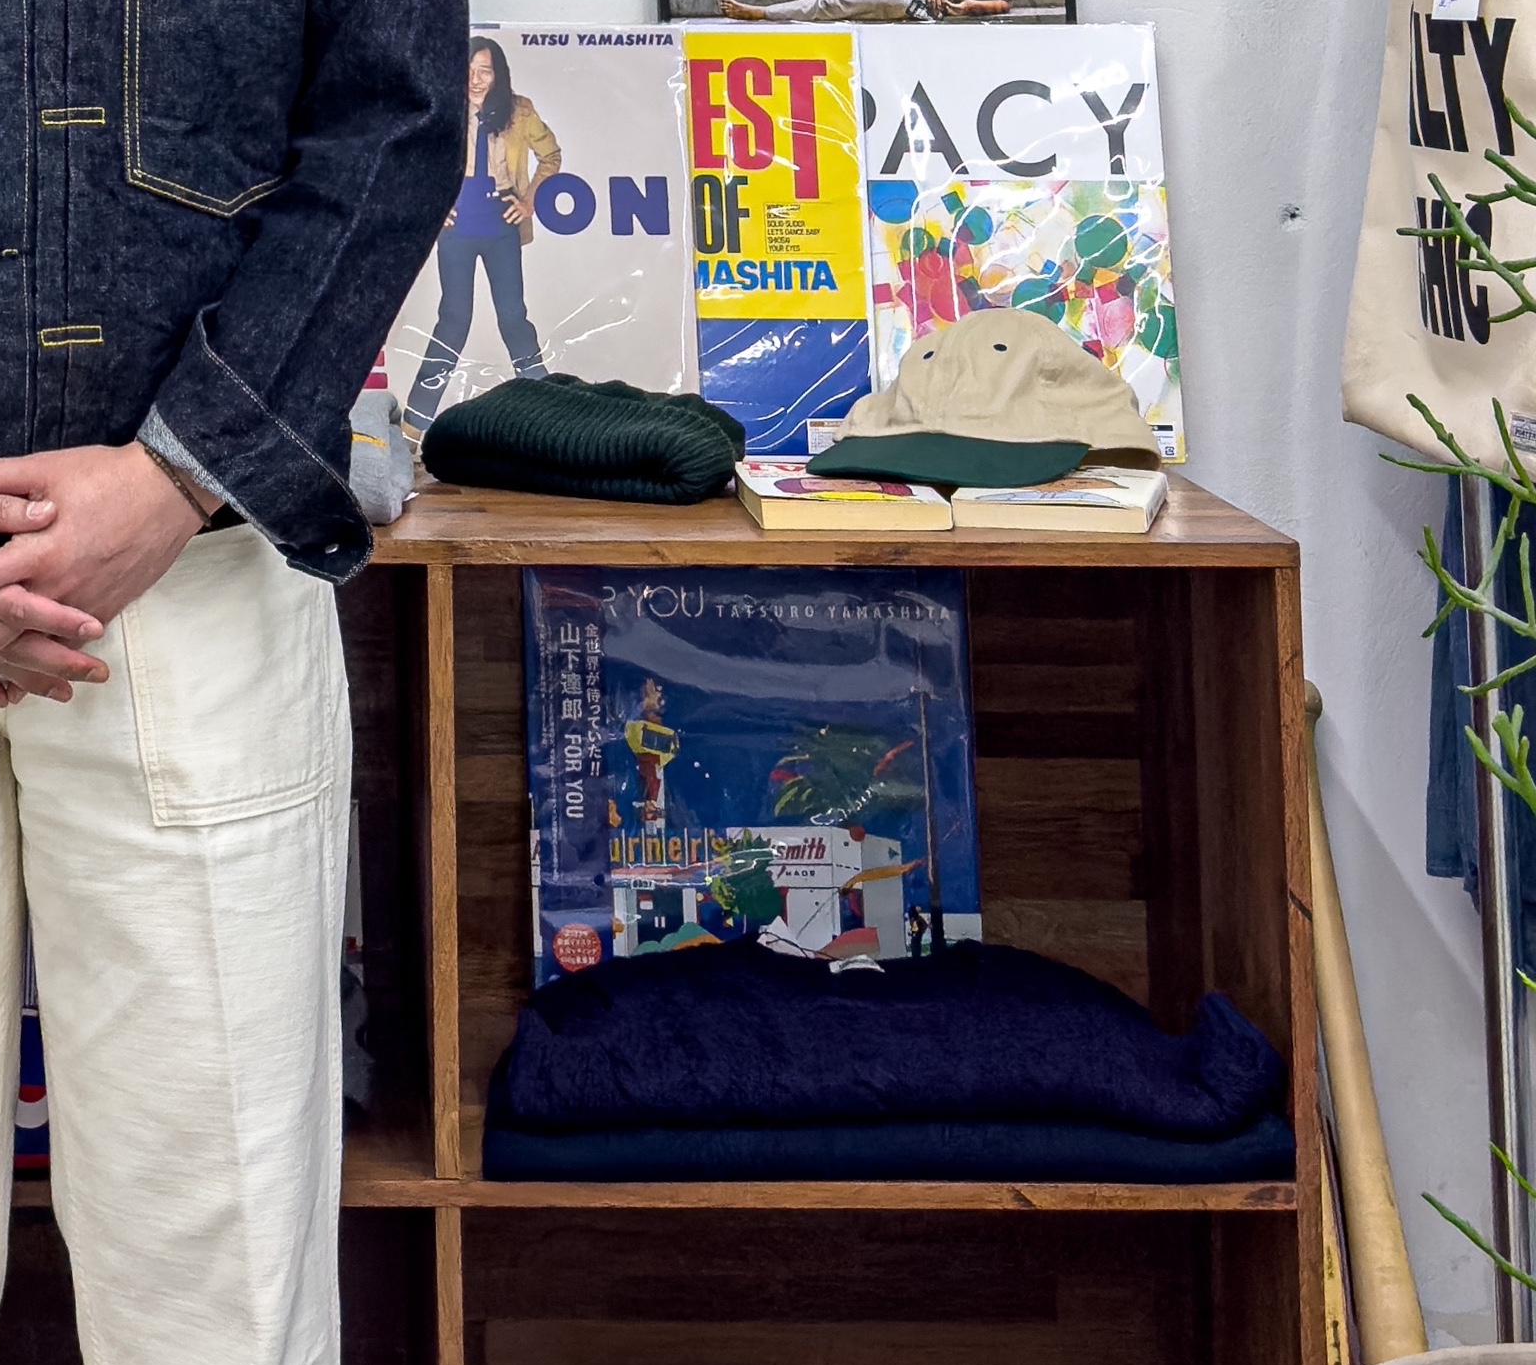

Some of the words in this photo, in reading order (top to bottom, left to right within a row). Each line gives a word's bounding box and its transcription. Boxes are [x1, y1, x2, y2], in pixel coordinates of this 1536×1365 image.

[520, 32, 570, 47] TATSU
[576, 32, 675, 47] YAMASHITA
[1410, 3, 1517, 157] LTY
[533, 172, 671, 236] ON
[693, 175, 750, 255] OF
[785, 244, 801, 252] EYES
[626, 584, 705, 619] YOU
[714, 604, 815, 620] TATSURO
[827, 603, 952, 621] YAMASHITA
[559, 622, 583, 721] 山下達郎
[564, 733, 583, 773] FOR
[565, 779, 585, 819] YOU
